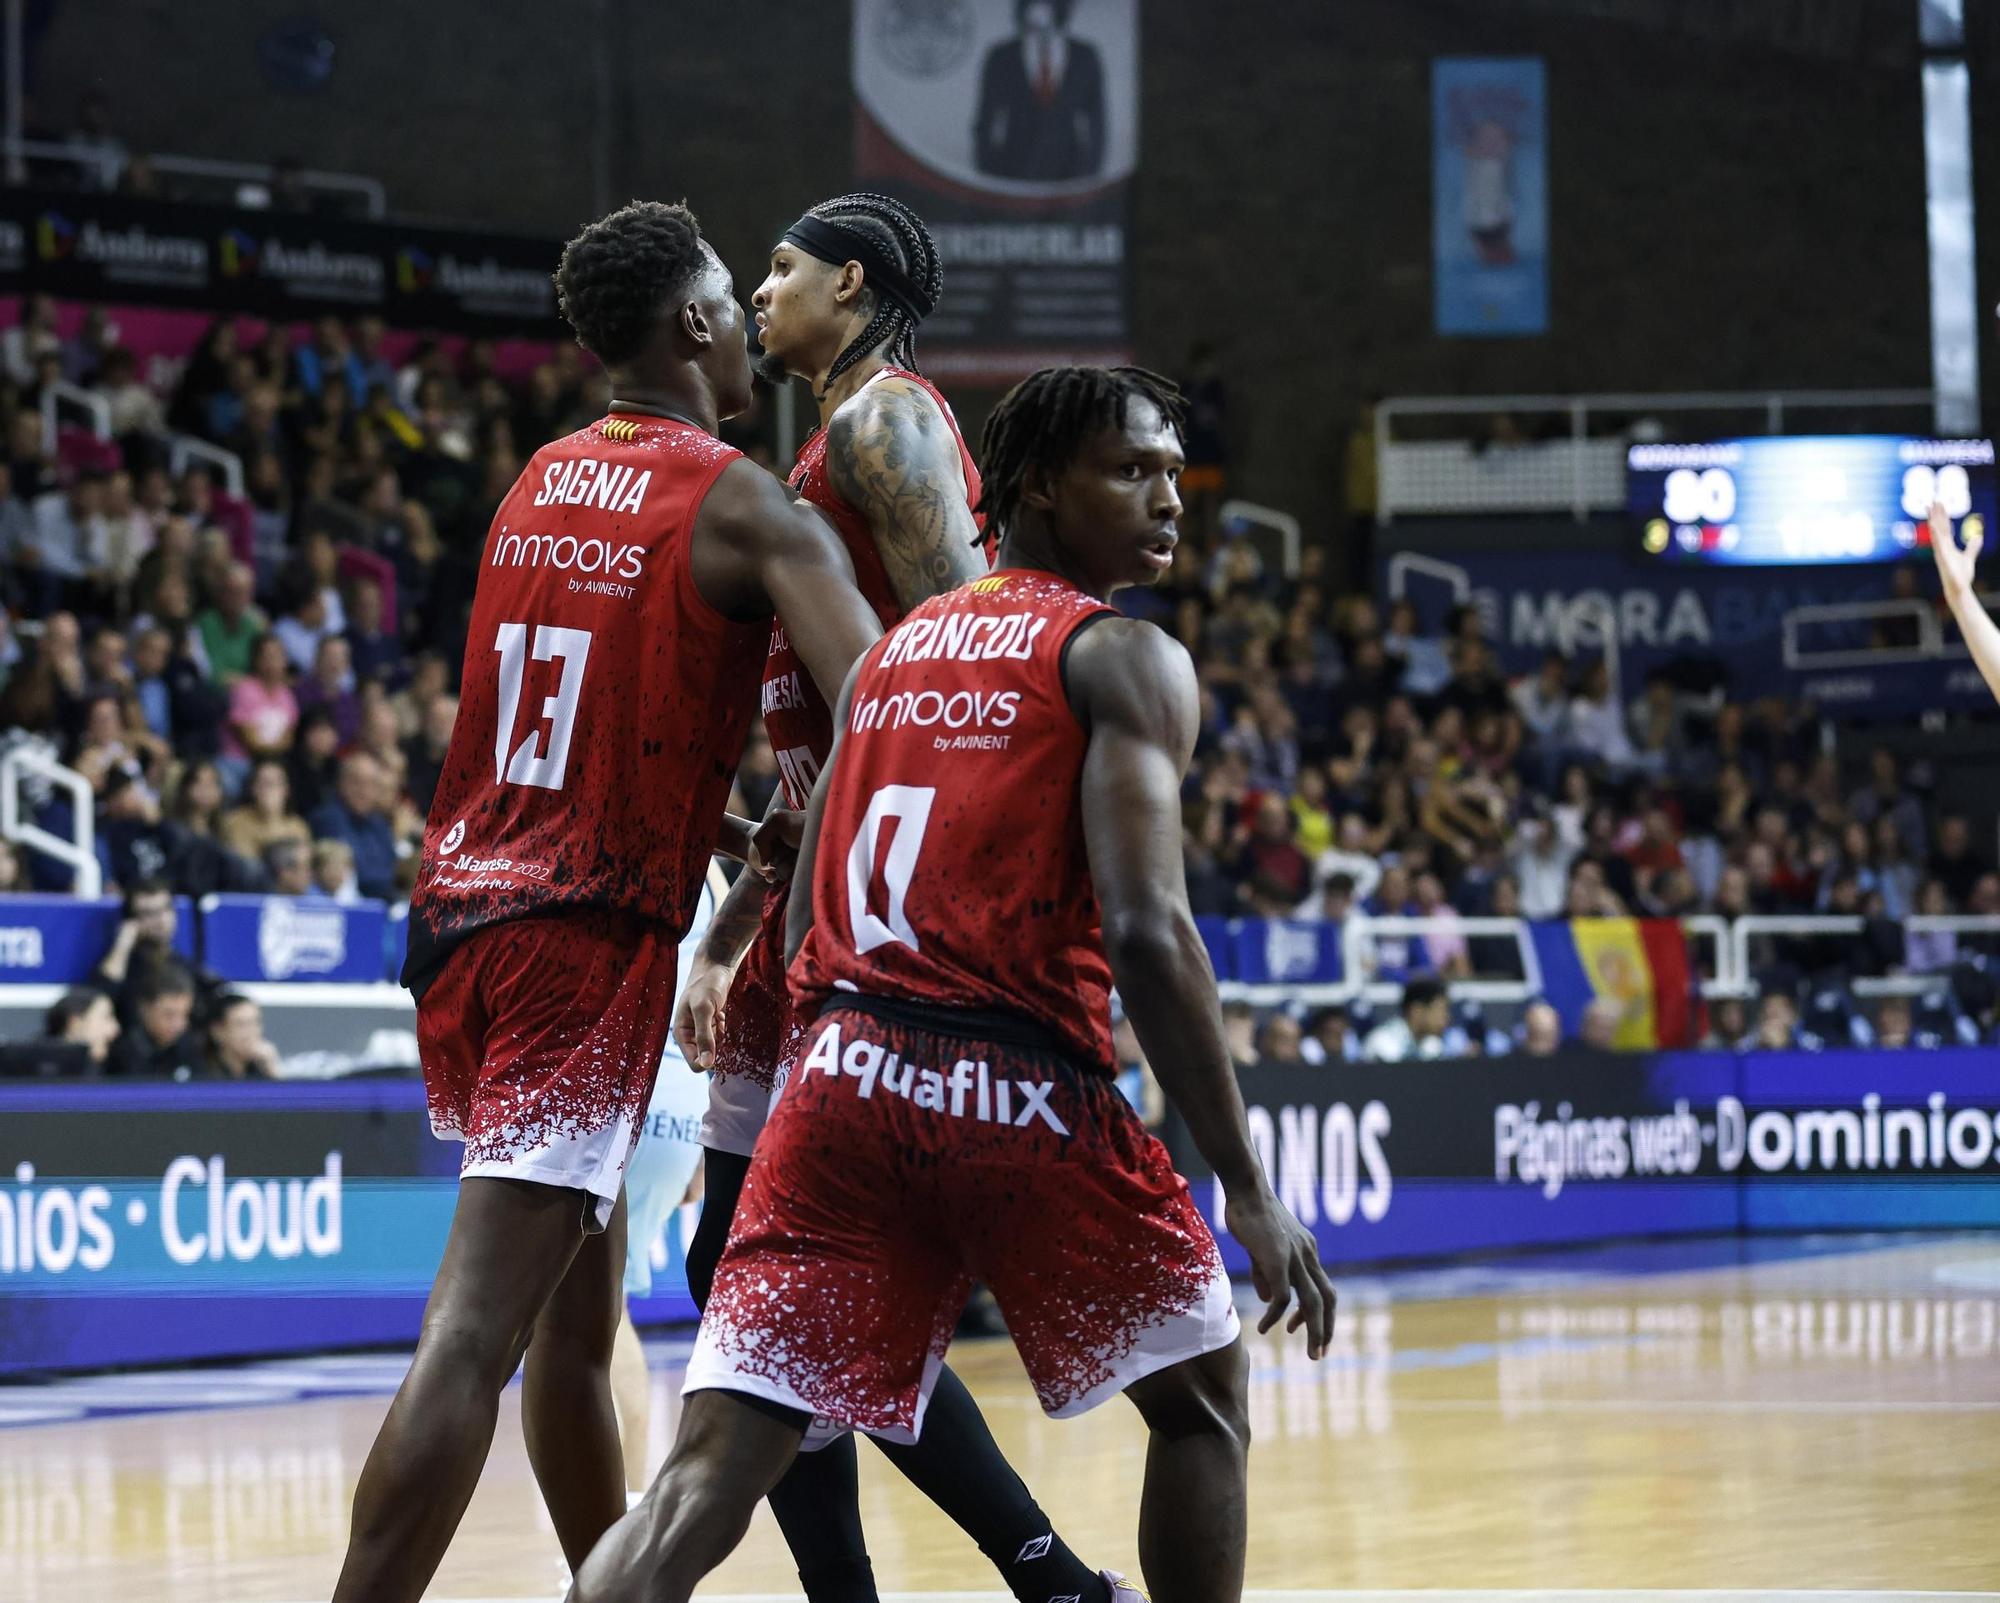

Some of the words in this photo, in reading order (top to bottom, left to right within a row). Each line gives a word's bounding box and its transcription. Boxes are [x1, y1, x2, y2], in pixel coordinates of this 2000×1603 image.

[533, 458, 653, 515] SAGNIA
[1663, 467, 1737, 524] 80
[1901, 464, 1972, 519] 88
[491, 525, 646, 579] inmoovs
[567, 577, 584, 594] by
[584, 581, 637, 600] AVINENT
[878, 611, 1048, 669] BRANCOU
[1510, 588, 1712, 649] MORA
[493, 622, 593, 791] 13
[851, 690, 1023, 734] inmoovs
[932, 735, 952, 752] by
[951, 735, 1012, 750] AVINENT
[511, 862, 550, 881] 2022
[847, 783, 937, 956] 0
[799, 1021, 1072, 1137] Aquaflix
[1494, 1100, 1629, 1200] Páginas
[160, 1150, 343, 1266] Cloud
